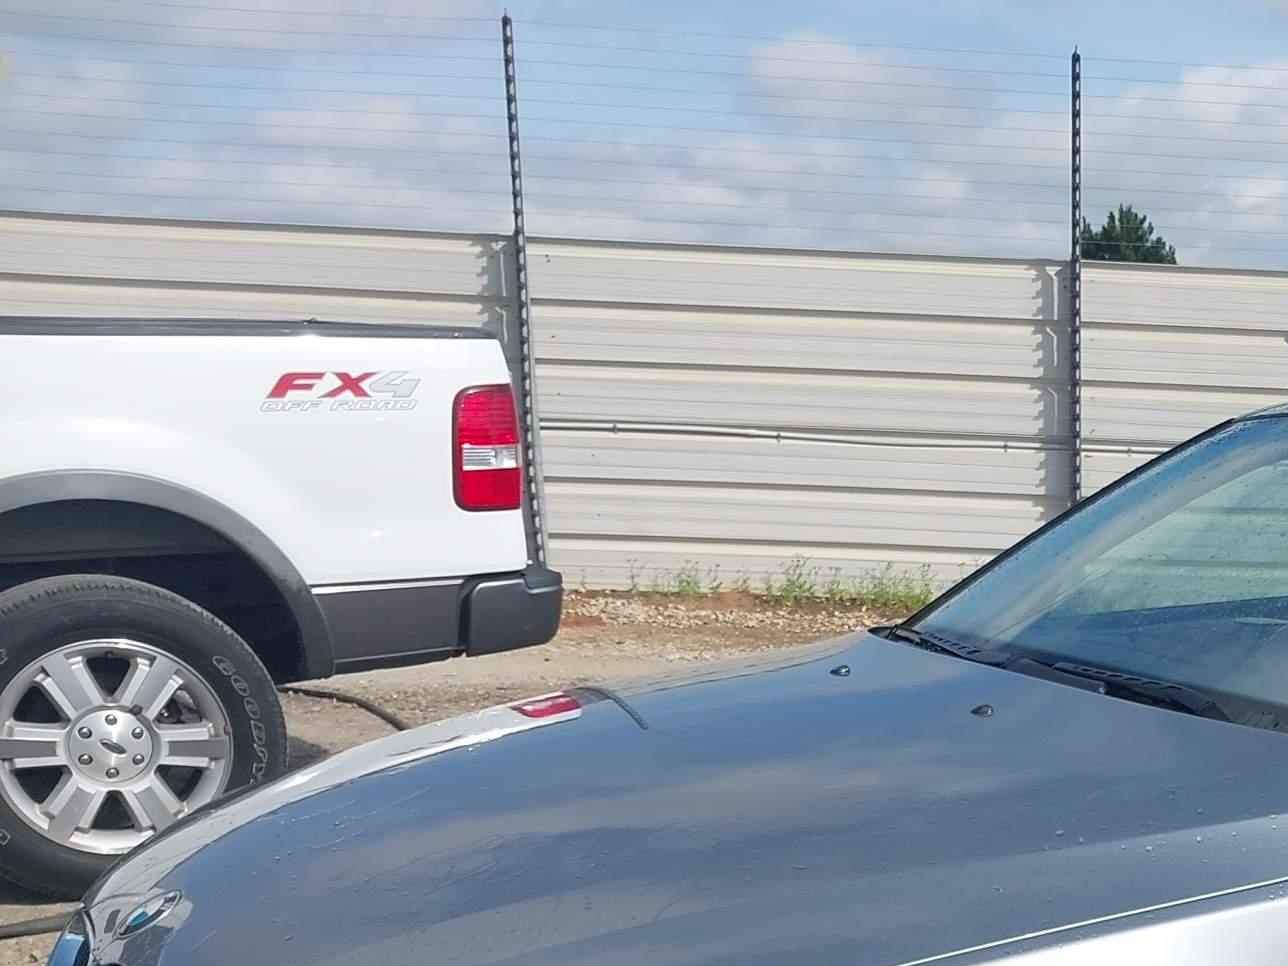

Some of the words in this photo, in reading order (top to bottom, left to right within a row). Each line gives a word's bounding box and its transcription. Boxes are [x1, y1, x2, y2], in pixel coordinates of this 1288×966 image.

[265, 371, 421, 399] FX4
[260, 400, 323, 412] OFF
[329, 400, 417, 411] ROAD
